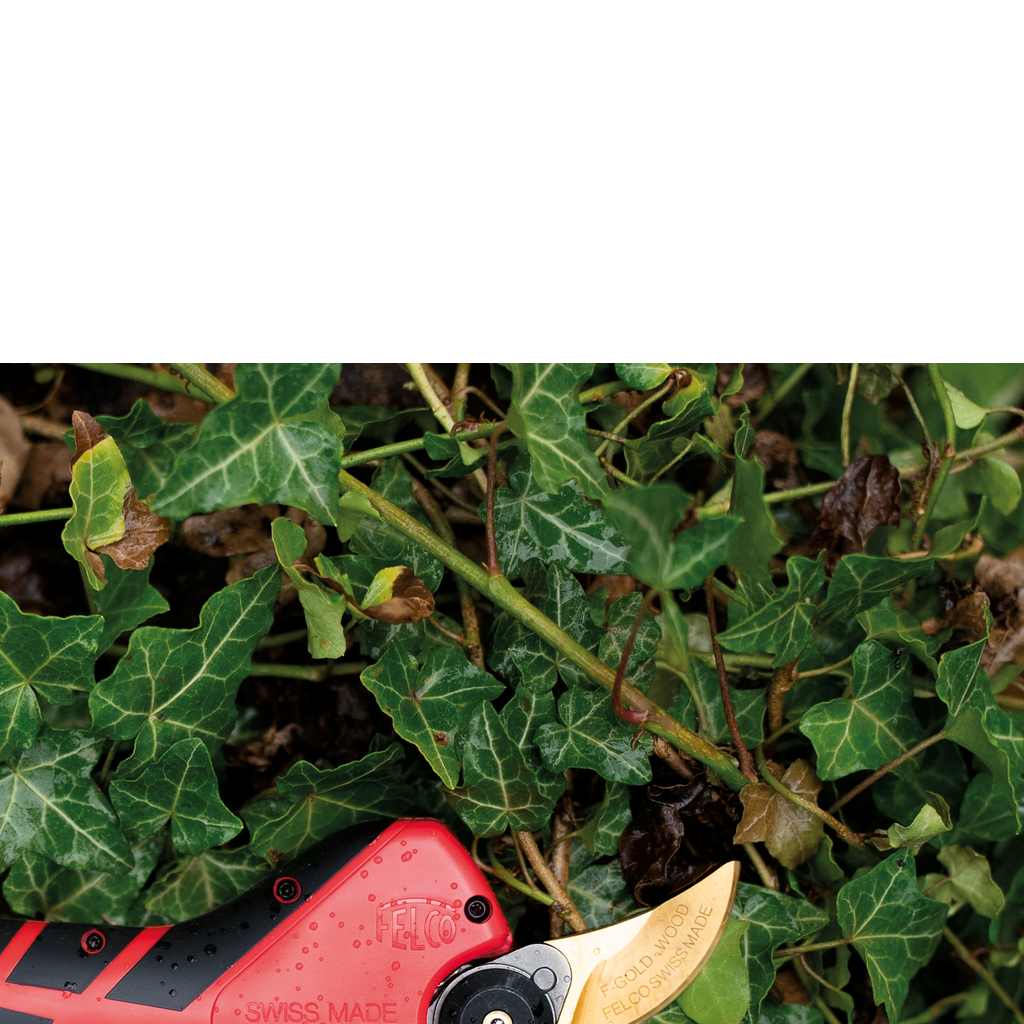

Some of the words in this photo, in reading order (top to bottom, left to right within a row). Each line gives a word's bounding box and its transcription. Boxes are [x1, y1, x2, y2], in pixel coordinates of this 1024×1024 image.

[376, 898, 457, 951] FELCO
[653, 903, 689, 951] WOOD
[601, 984, 651, 1020] FELCO
[648, 947, 688, 989] SWISS
[682, 904, 713, 950] MADE
[244, 1001, 320, 1024] SWISS
[328, 1002, 398, 1024] MADE
